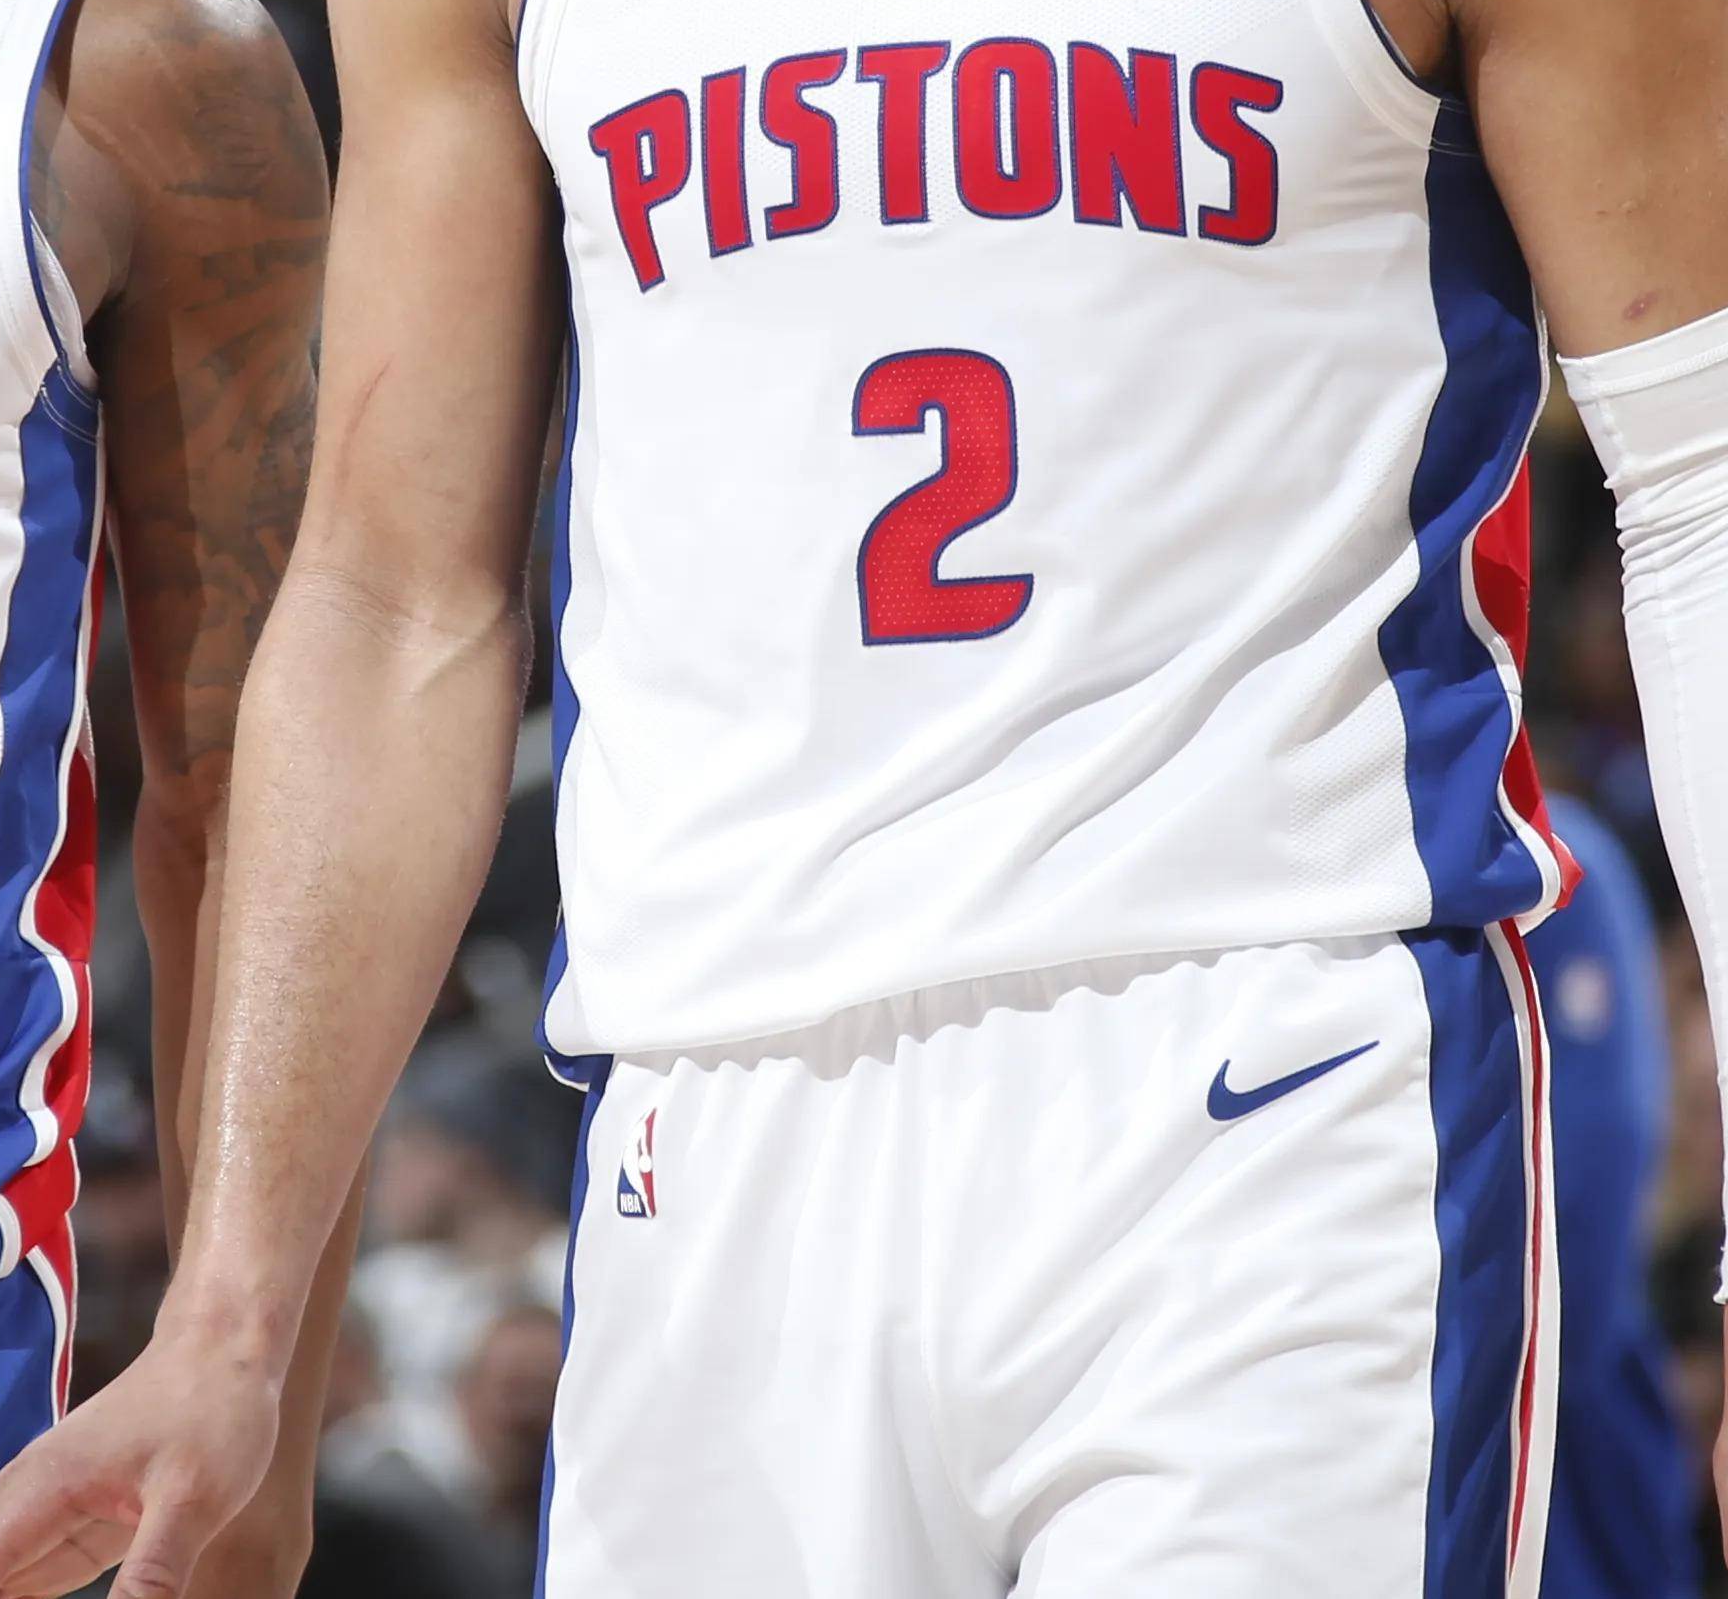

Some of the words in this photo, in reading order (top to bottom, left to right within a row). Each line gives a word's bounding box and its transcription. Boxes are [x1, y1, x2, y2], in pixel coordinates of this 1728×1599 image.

[589, 37, 1283, 291] PISTONS
[853, 348, 1033, 645] 2
[620, 1192, 642, 1213] NBA
